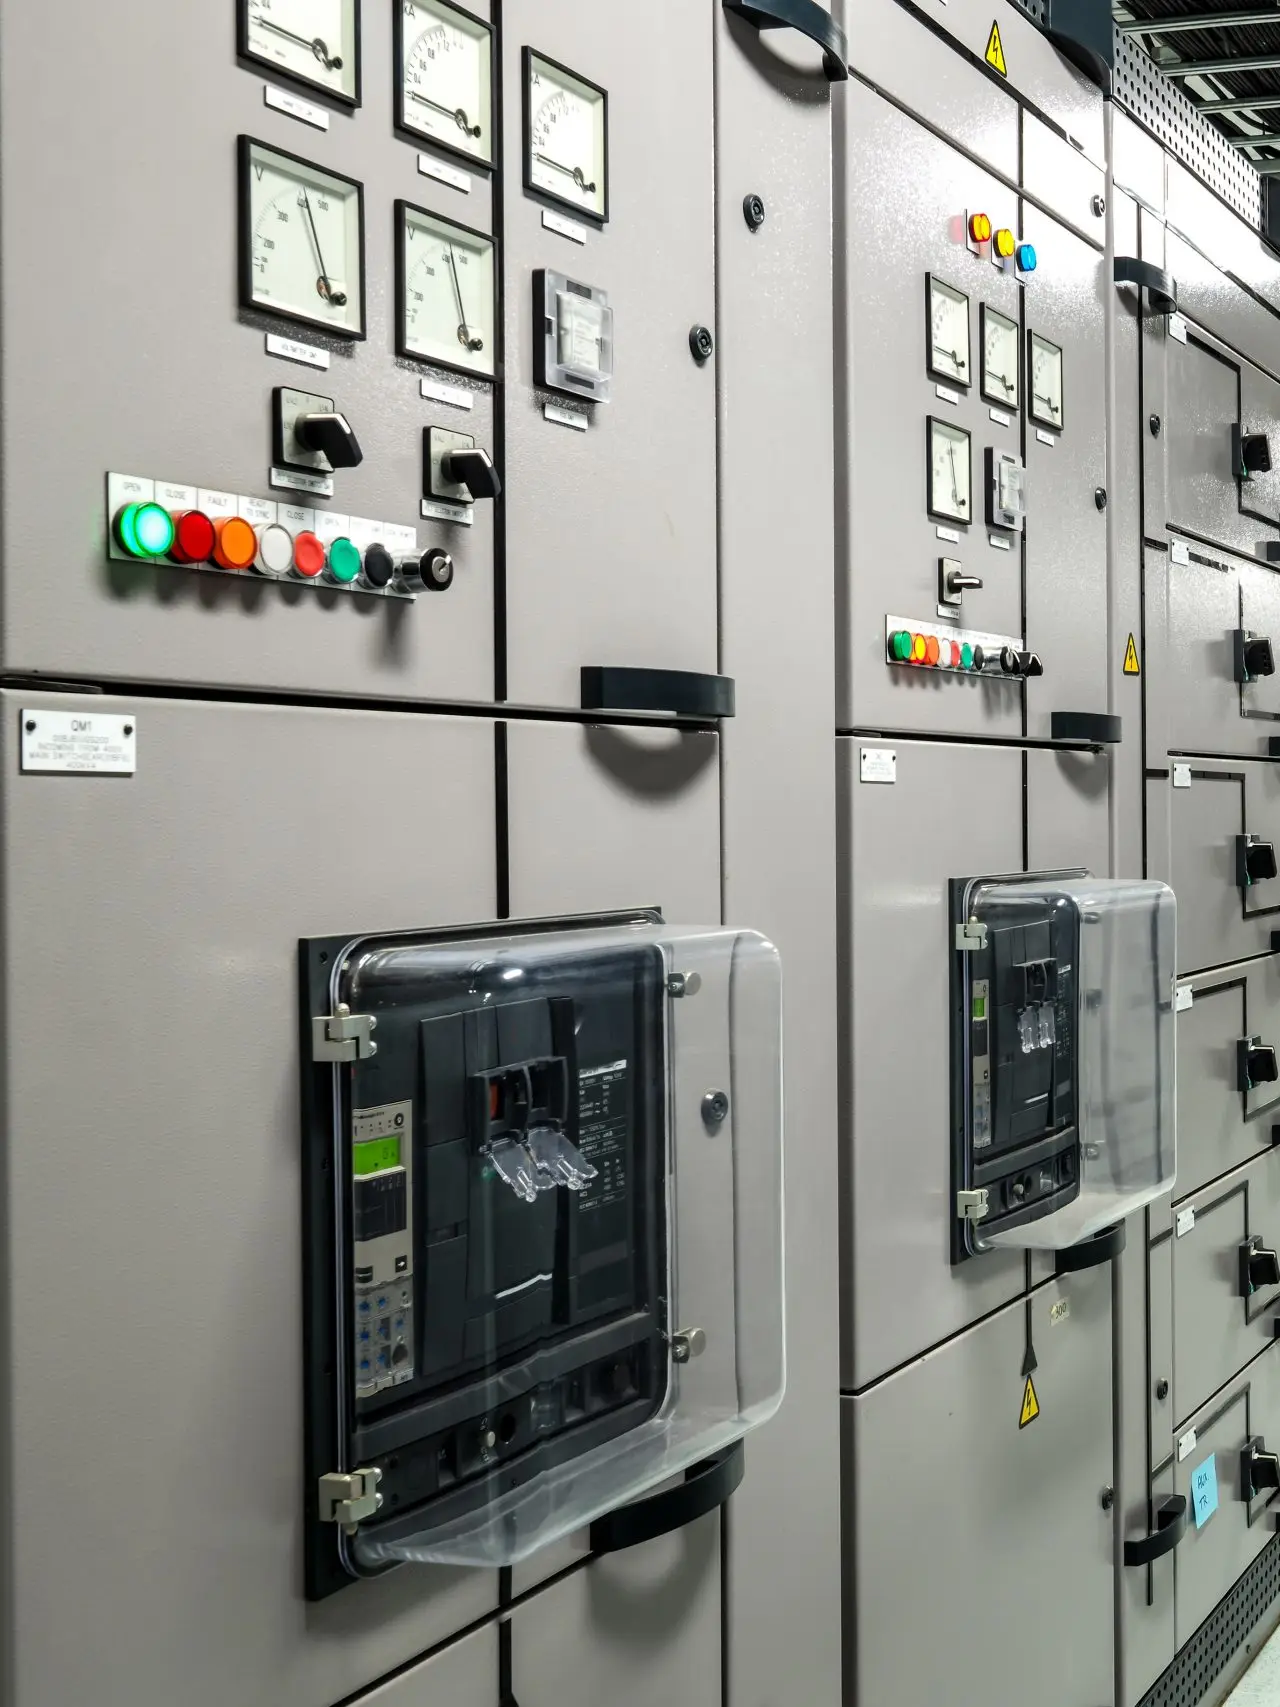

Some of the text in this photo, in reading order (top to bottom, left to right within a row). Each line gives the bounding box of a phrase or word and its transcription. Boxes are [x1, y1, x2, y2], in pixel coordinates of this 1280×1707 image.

[317, 199, 329, 212] 500
[277, 209, 290, 223] 300
[263, 239, 275, 251] 200
[123, 481, 142, 492] OPEN
[165, 488, 186, 501] CLOSE
[207, 496, 228, 507] FAULT
[286, 510, 305, 521] CLOSE
